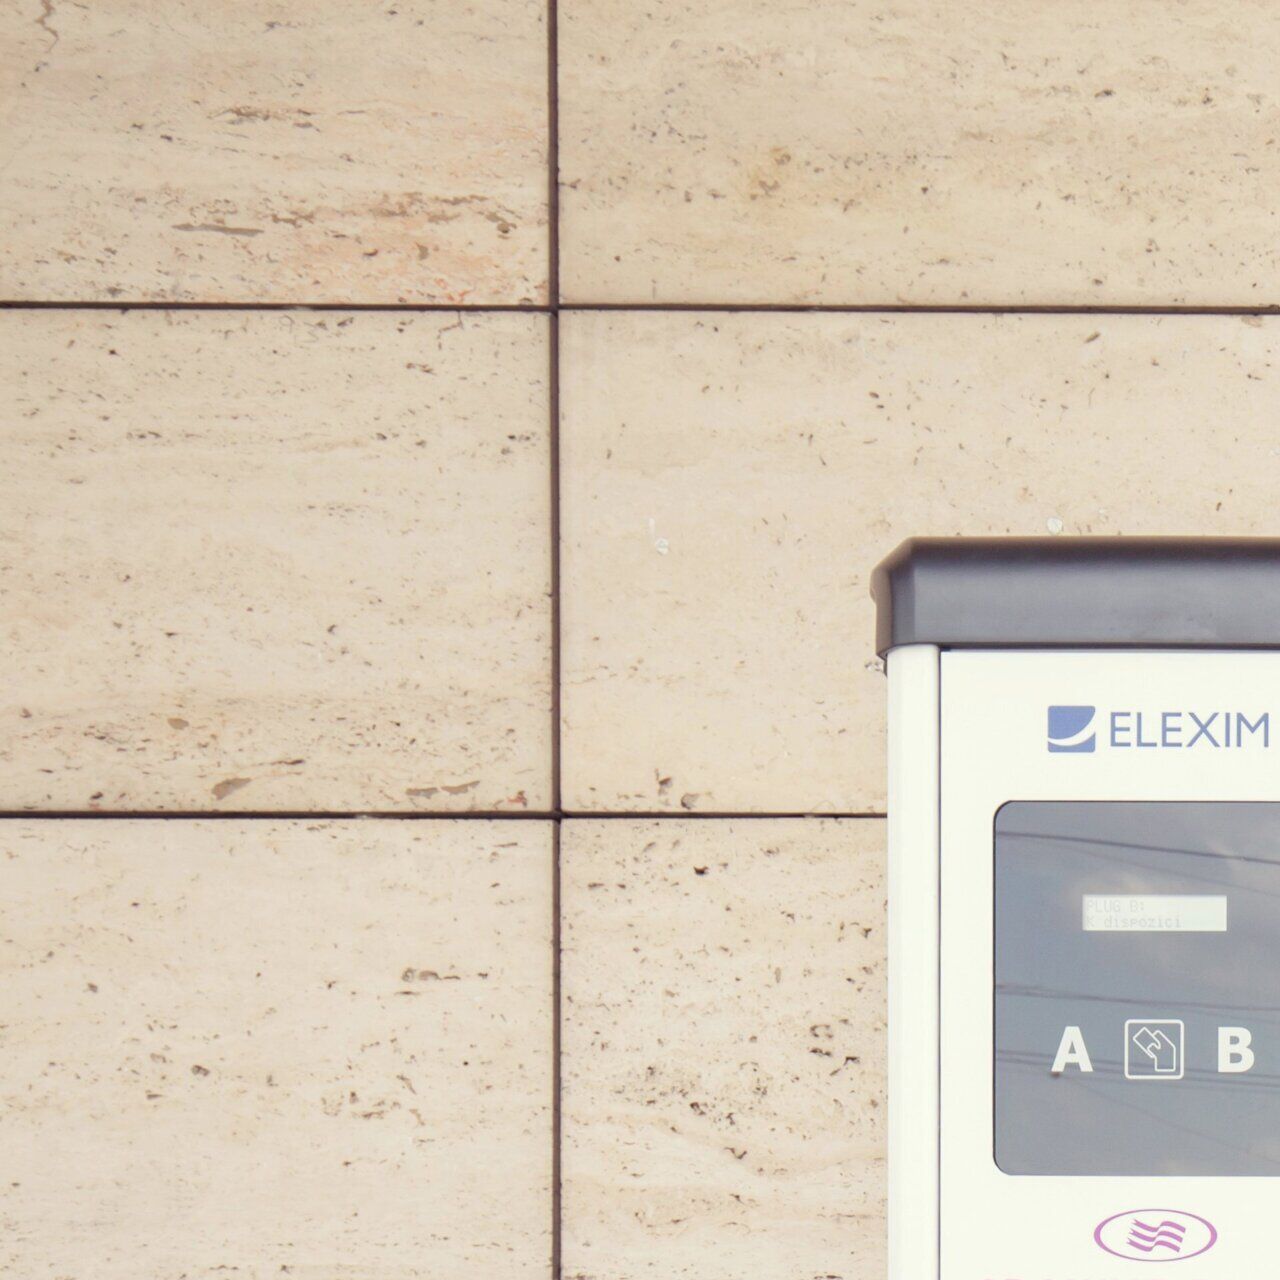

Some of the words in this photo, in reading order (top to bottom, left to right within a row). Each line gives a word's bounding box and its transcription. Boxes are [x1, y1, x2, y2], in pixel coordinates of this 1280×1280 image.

[1109, 712, 1271, 749] ELEXIM
[1086, 898, 1121, 913] PLUG
[1052, 1027, 1094, 1073] A
[1218, 1028, 1256, 1073] B
